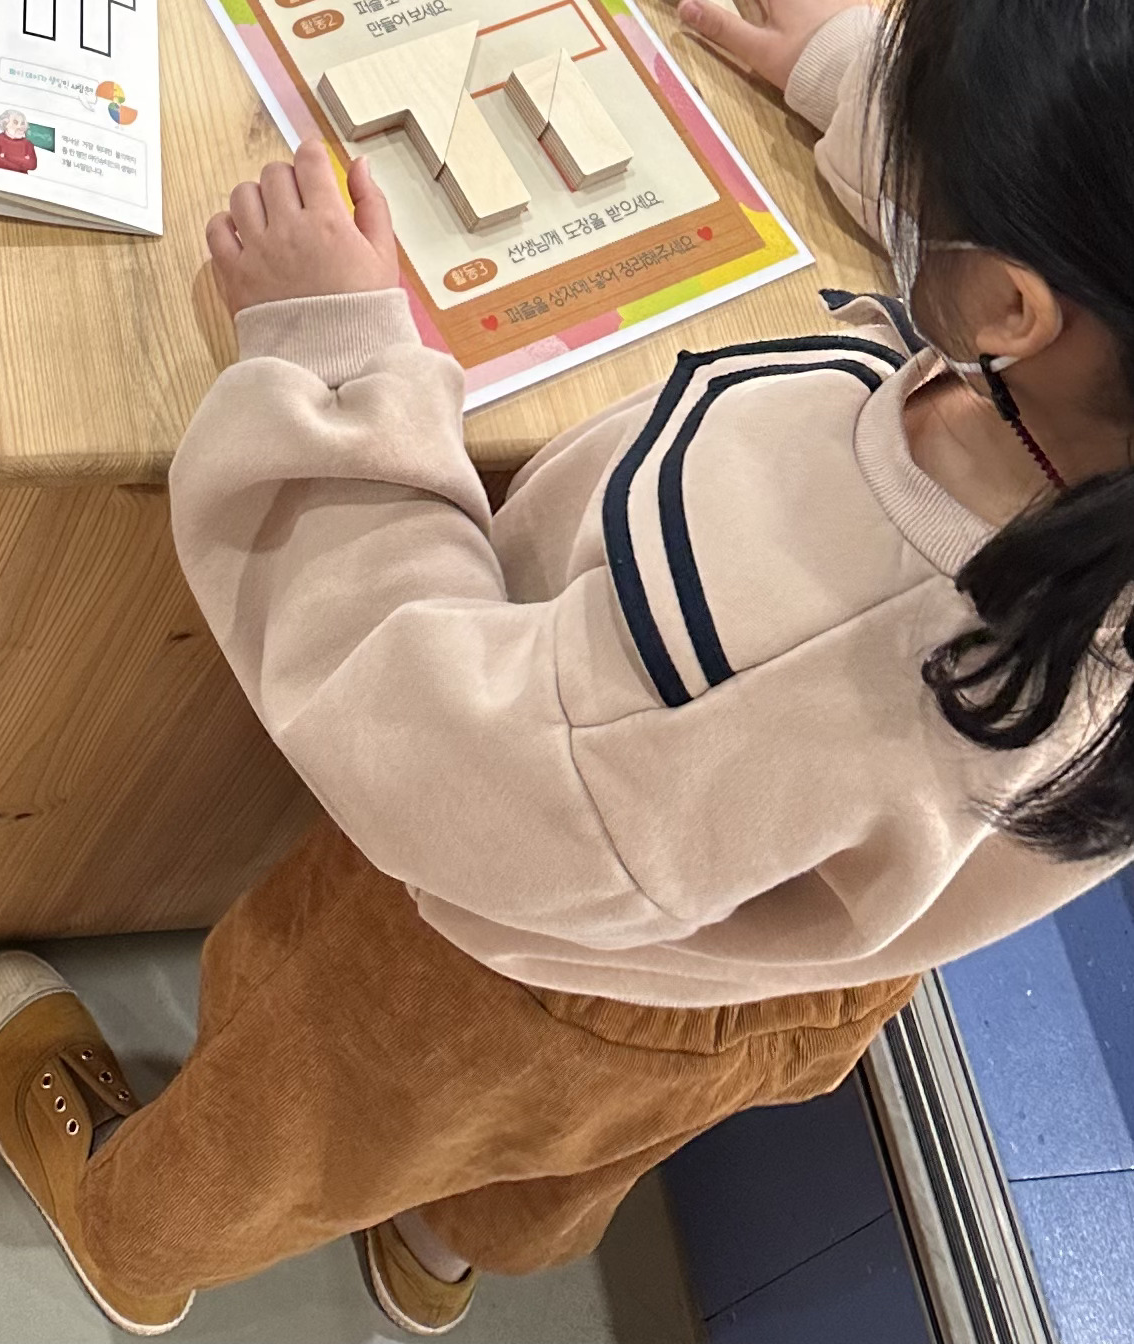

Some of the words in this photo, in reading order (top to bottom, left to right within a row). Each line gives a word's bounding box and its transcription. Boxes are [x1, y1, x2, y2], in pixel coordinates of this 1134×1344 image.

[300, 13, 338, 35] 활동2
[365, 12, 411, 38] 만들어
[450, 261, 490, 286] 활동3
[507, 229, 564, 264] 선생님께
[562, 212, 607, 241] 도장을
[504, 296, 550, 325] 퍼즐을
[548, 279, 591, 308] 상자에
[588, 267, 623, 290] 넣어
[614, 234, 698, 278] 정리해주세요
